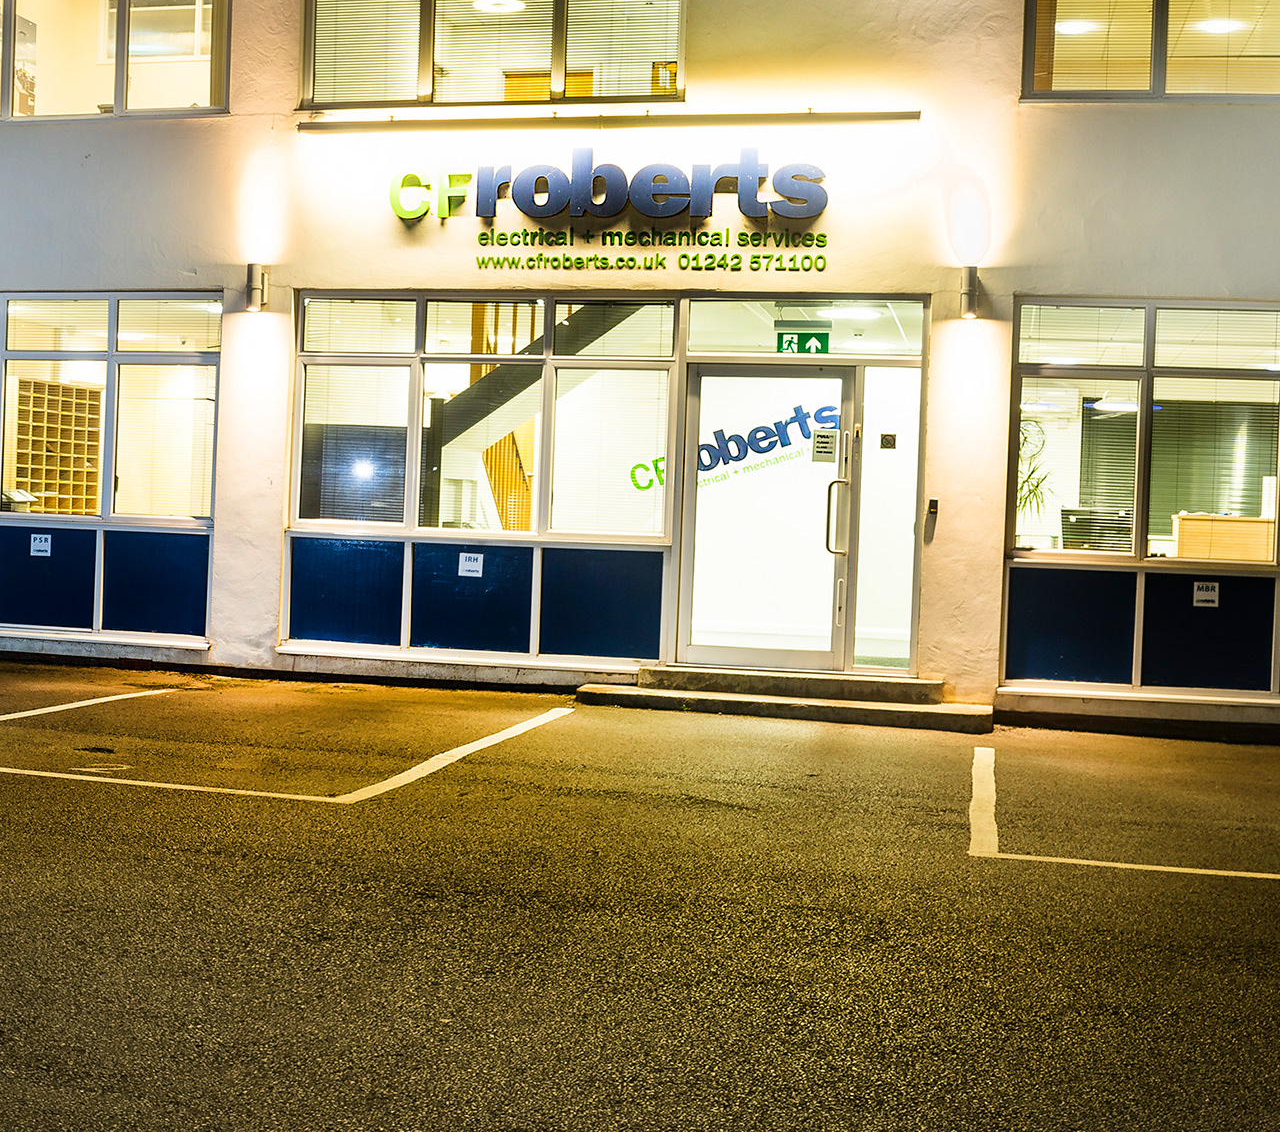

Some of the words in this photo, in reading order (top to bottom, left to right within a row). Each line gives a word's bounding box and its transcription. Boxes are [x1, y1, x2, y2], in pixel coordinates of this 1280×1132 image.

[389, 148, 829, 221] CFroberts
[477, 227, 575, 247] electrical
[581, 229, 595, 244] +
[601, 227, 730, 247] mechanical
[737, 228, 828, 248] services
[476, 252, 667, 271] www.cfroberts.co.uk
[677, 253, 743, 271] 01242
[749, 254, 827, 272] 571100
[697, 470, 730, 488] ctrical
[743, 448, 805, 474] mechanical
